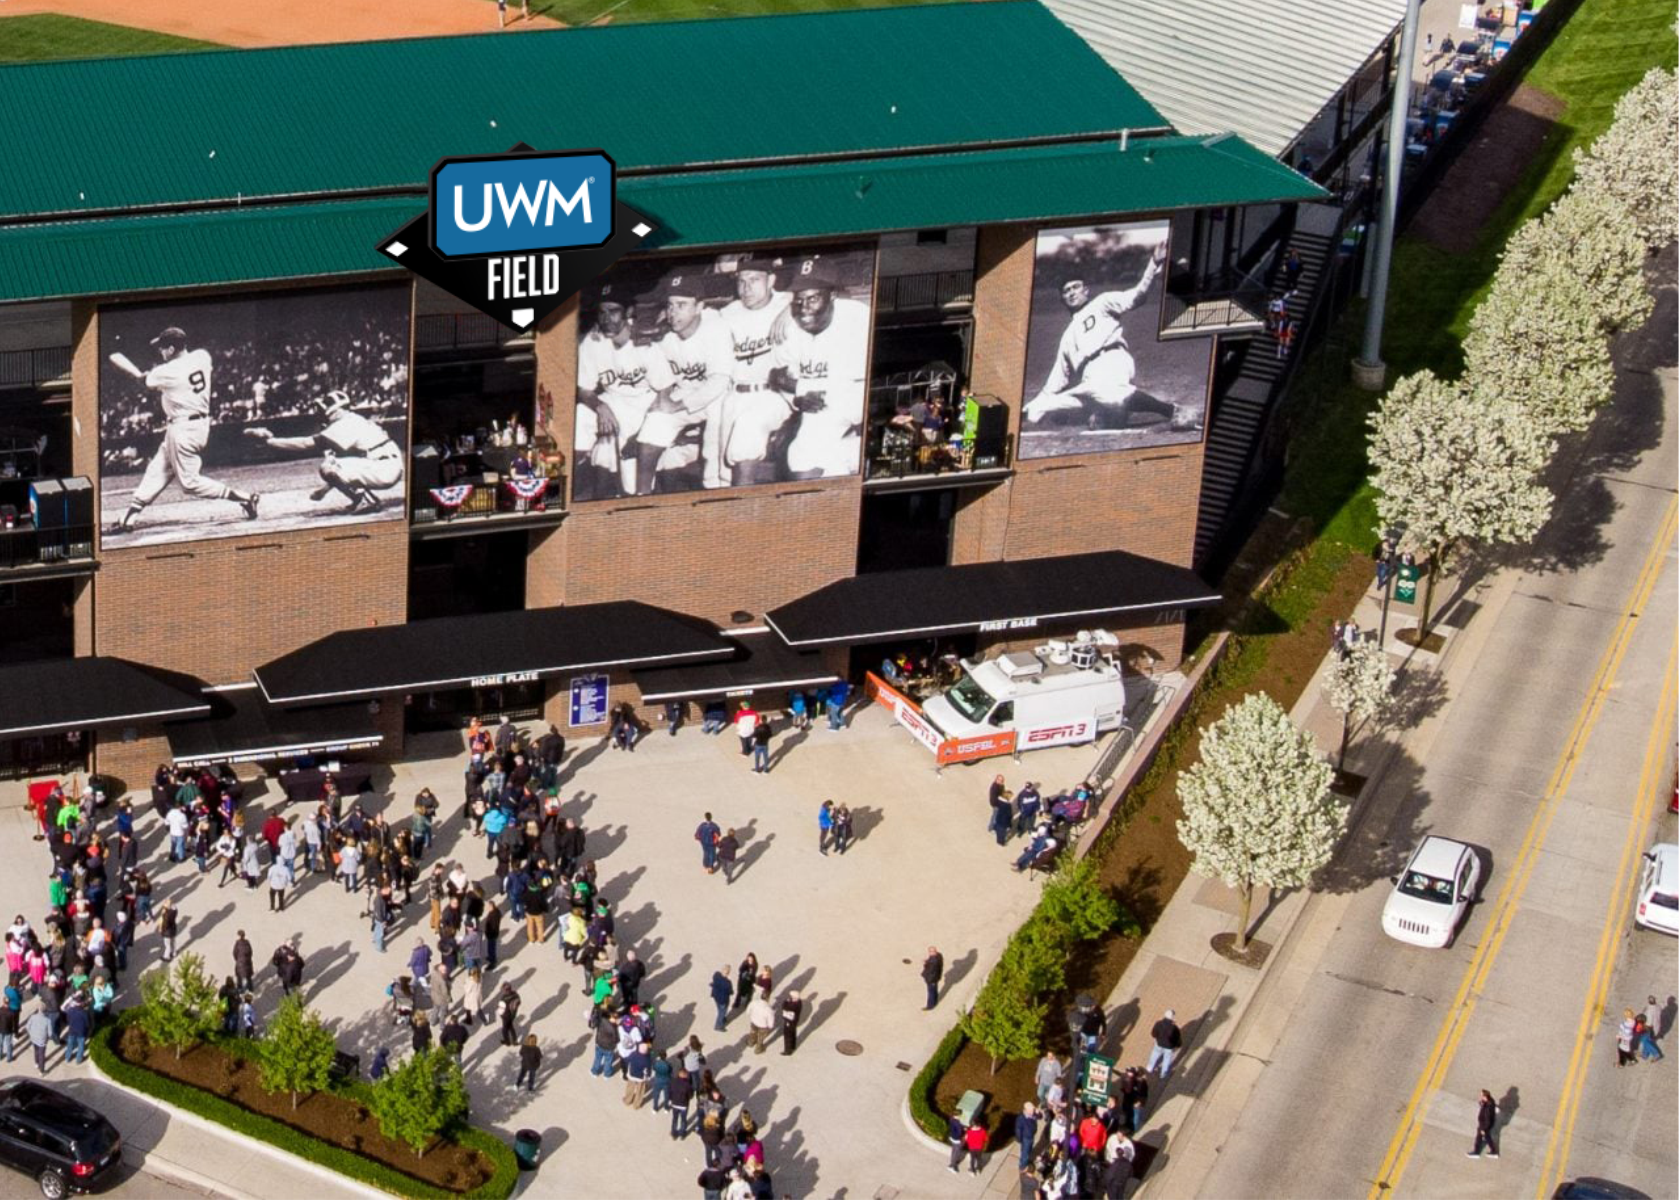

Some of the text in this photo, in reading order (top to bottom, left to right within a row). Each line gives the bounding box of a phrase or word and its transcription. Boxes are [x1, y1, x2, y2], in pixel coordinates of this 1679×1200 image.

[488, 253, 560, 301] FIELD
[801, 260, 813, 276] B
[1083, 314, 1096, 334] D
[188, 369, 206, 395] 9
[979, 617, 1037, 632] FIRST BASE
[471, 671, 539, 687] HOME PLATE
